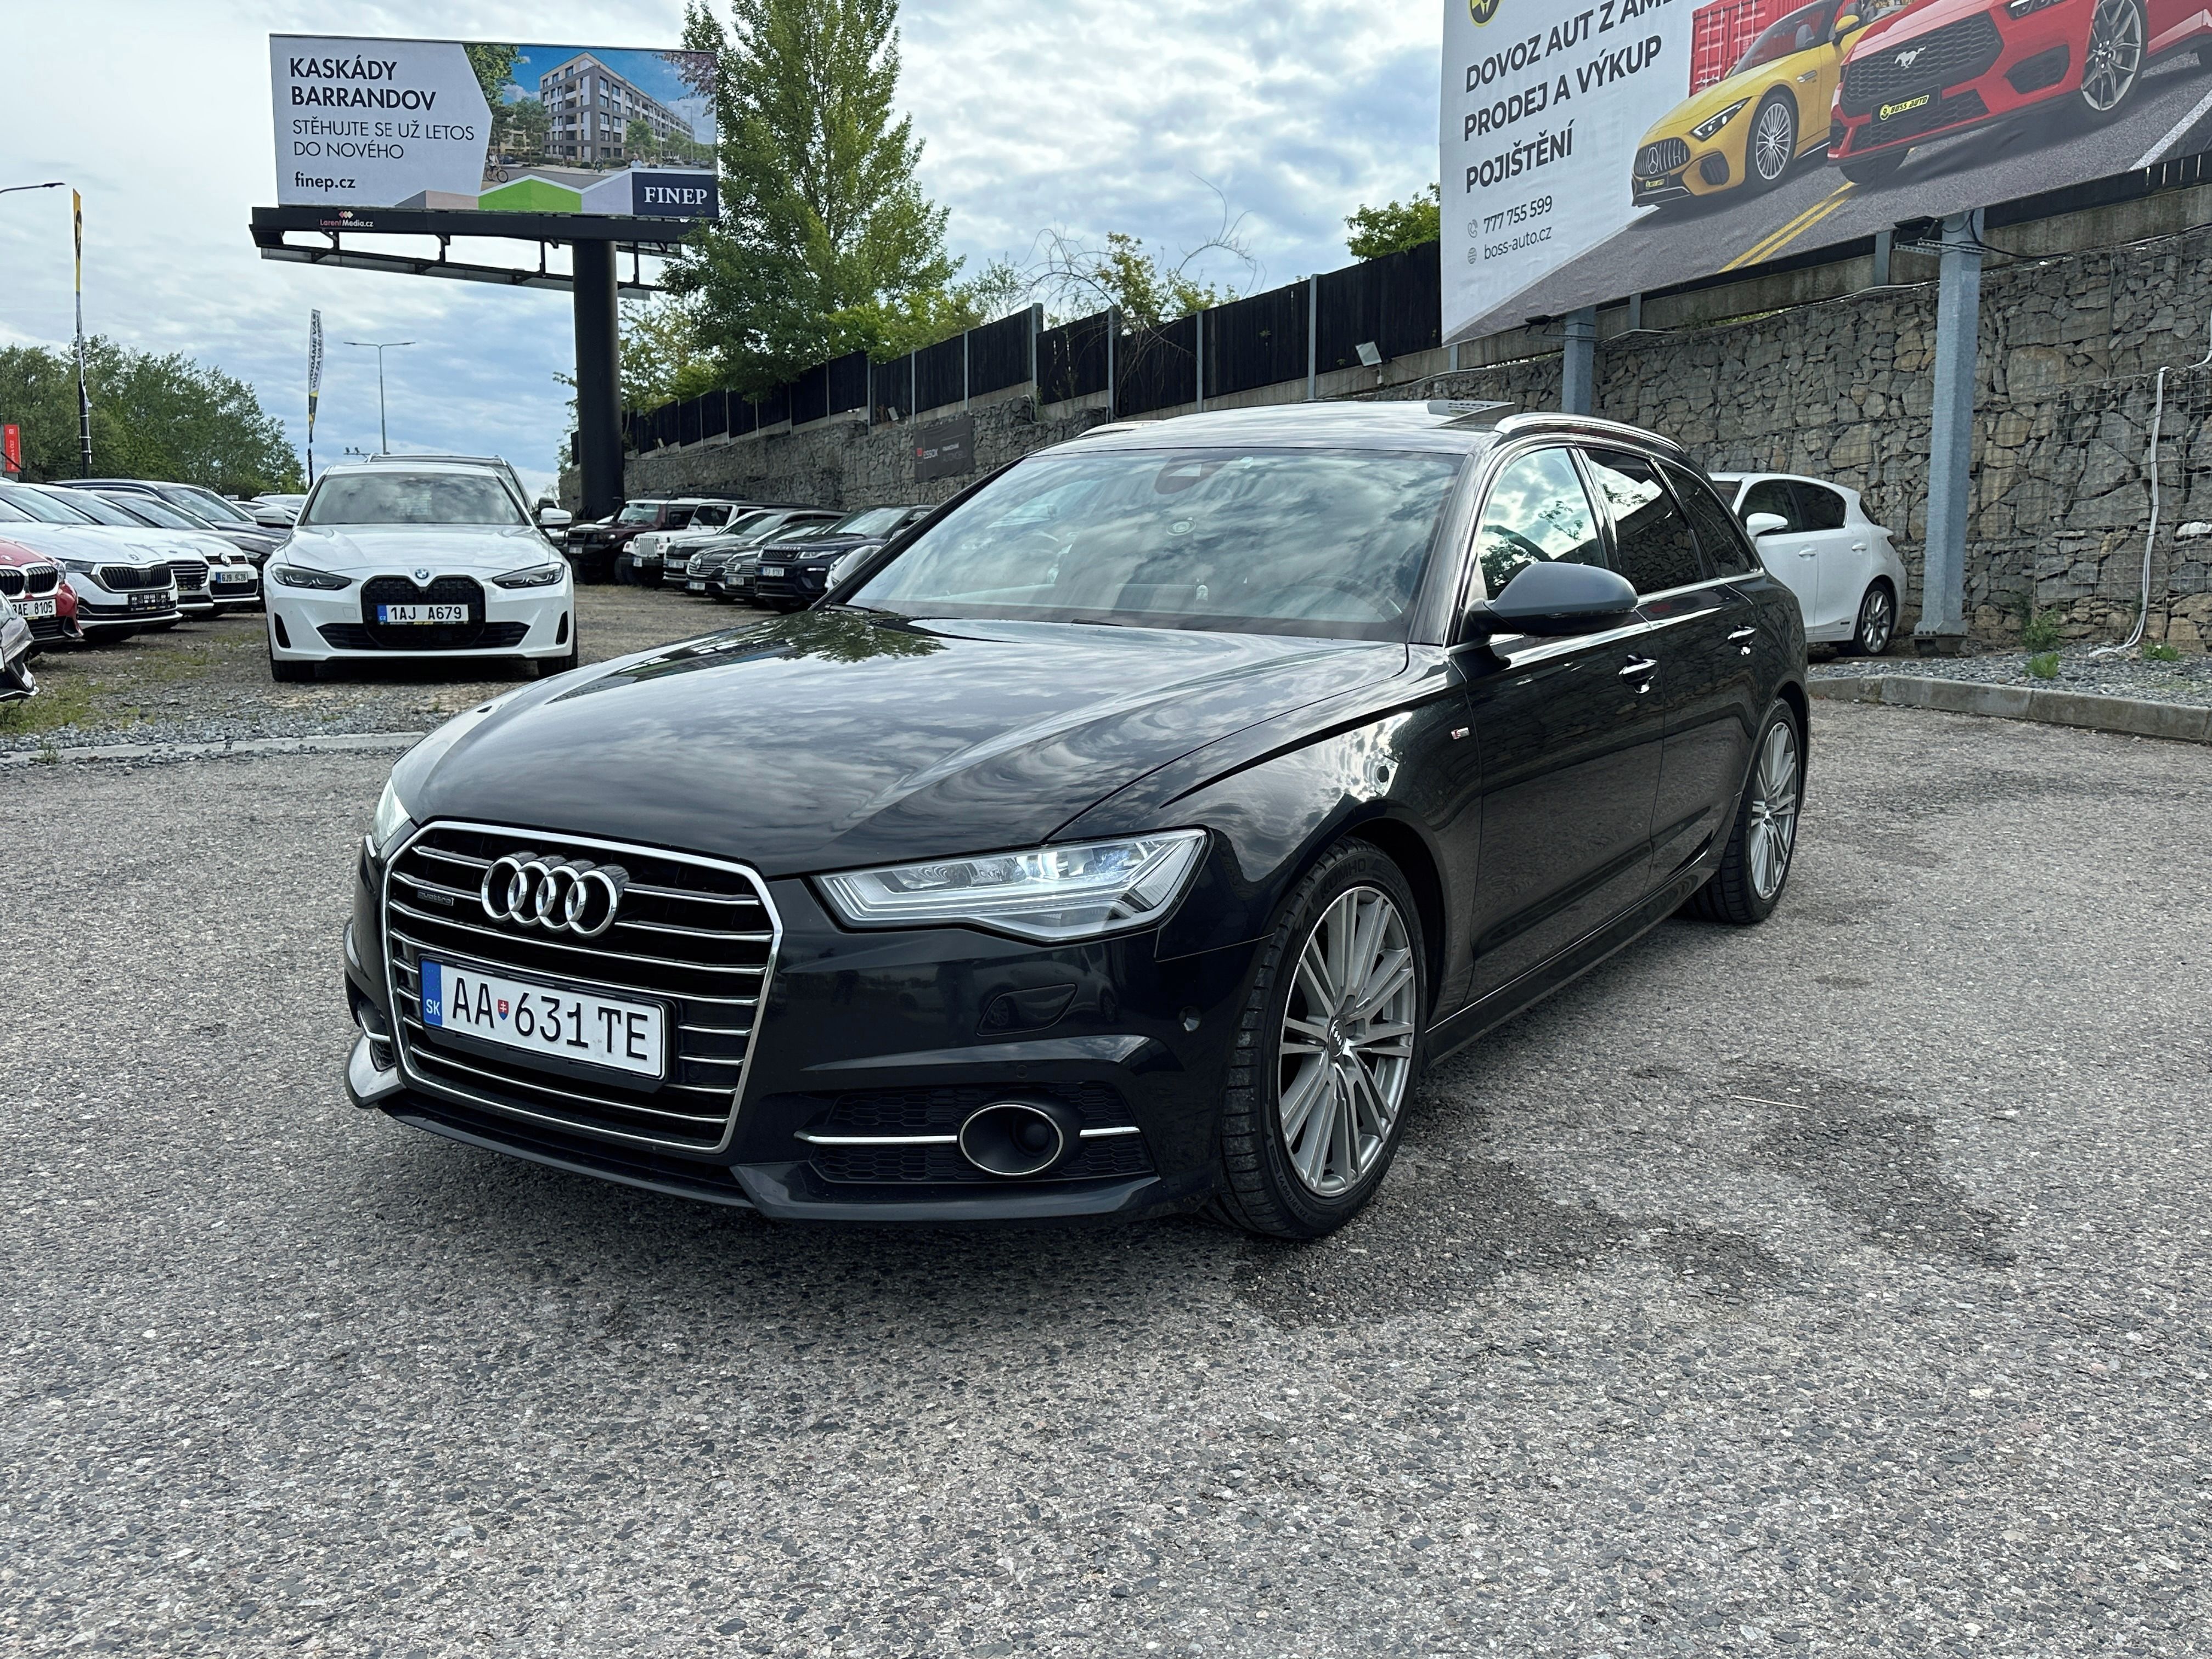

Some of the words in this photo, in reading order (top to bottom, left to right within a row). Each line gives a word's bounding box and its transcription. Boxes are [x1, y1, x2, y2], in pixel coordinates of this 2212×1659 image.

[1465, 33, 1541, 93] DOVOZ
[1545, 9, 1594, 58] AUT
[1599, 1, 1614, 33] Z
[1620, 0, 1673, 24] AM
[290, 54, 397, 81] KASKÁDY
[291, 86, 436, 111] BARRANDOV
[1465, 82, 1548, 142] PRODEJ
[1553, 74, 1571, 105] A
[1576, 35, 1662, 94] VÝKUP
[292, 116, 369, 137] STĚHUJTE
[375, 122, 392, 137] SE
[398, 120, 420, 139] UŽ
[426, 125, 475, 140] LETOS
[294, 141, 321, 156] DO
[326, 139, 404, 159] NOVÉHO
[1466, 119, 1575, 194] POJIŠTĚNÍ
[295, 171, 356, 192] finep.cz
[644, 187, 708, 205] FINEP
[1483, 212, 1504, 234] 777
[1507, 204, 1527, 226] 755
[1530, 195, 1553, 218] 599
[1484, 227, 1552, 260] boss-auto.cz
[34, 601, 53, 614] 8105
[391, 607, 416, 620] 1AJ
[428, 607, 462, 620] A679
[417, 891, 452, 904] quattro
[426, 998, 441, 1017] SK
[453, 977, 495, 1029] AA
